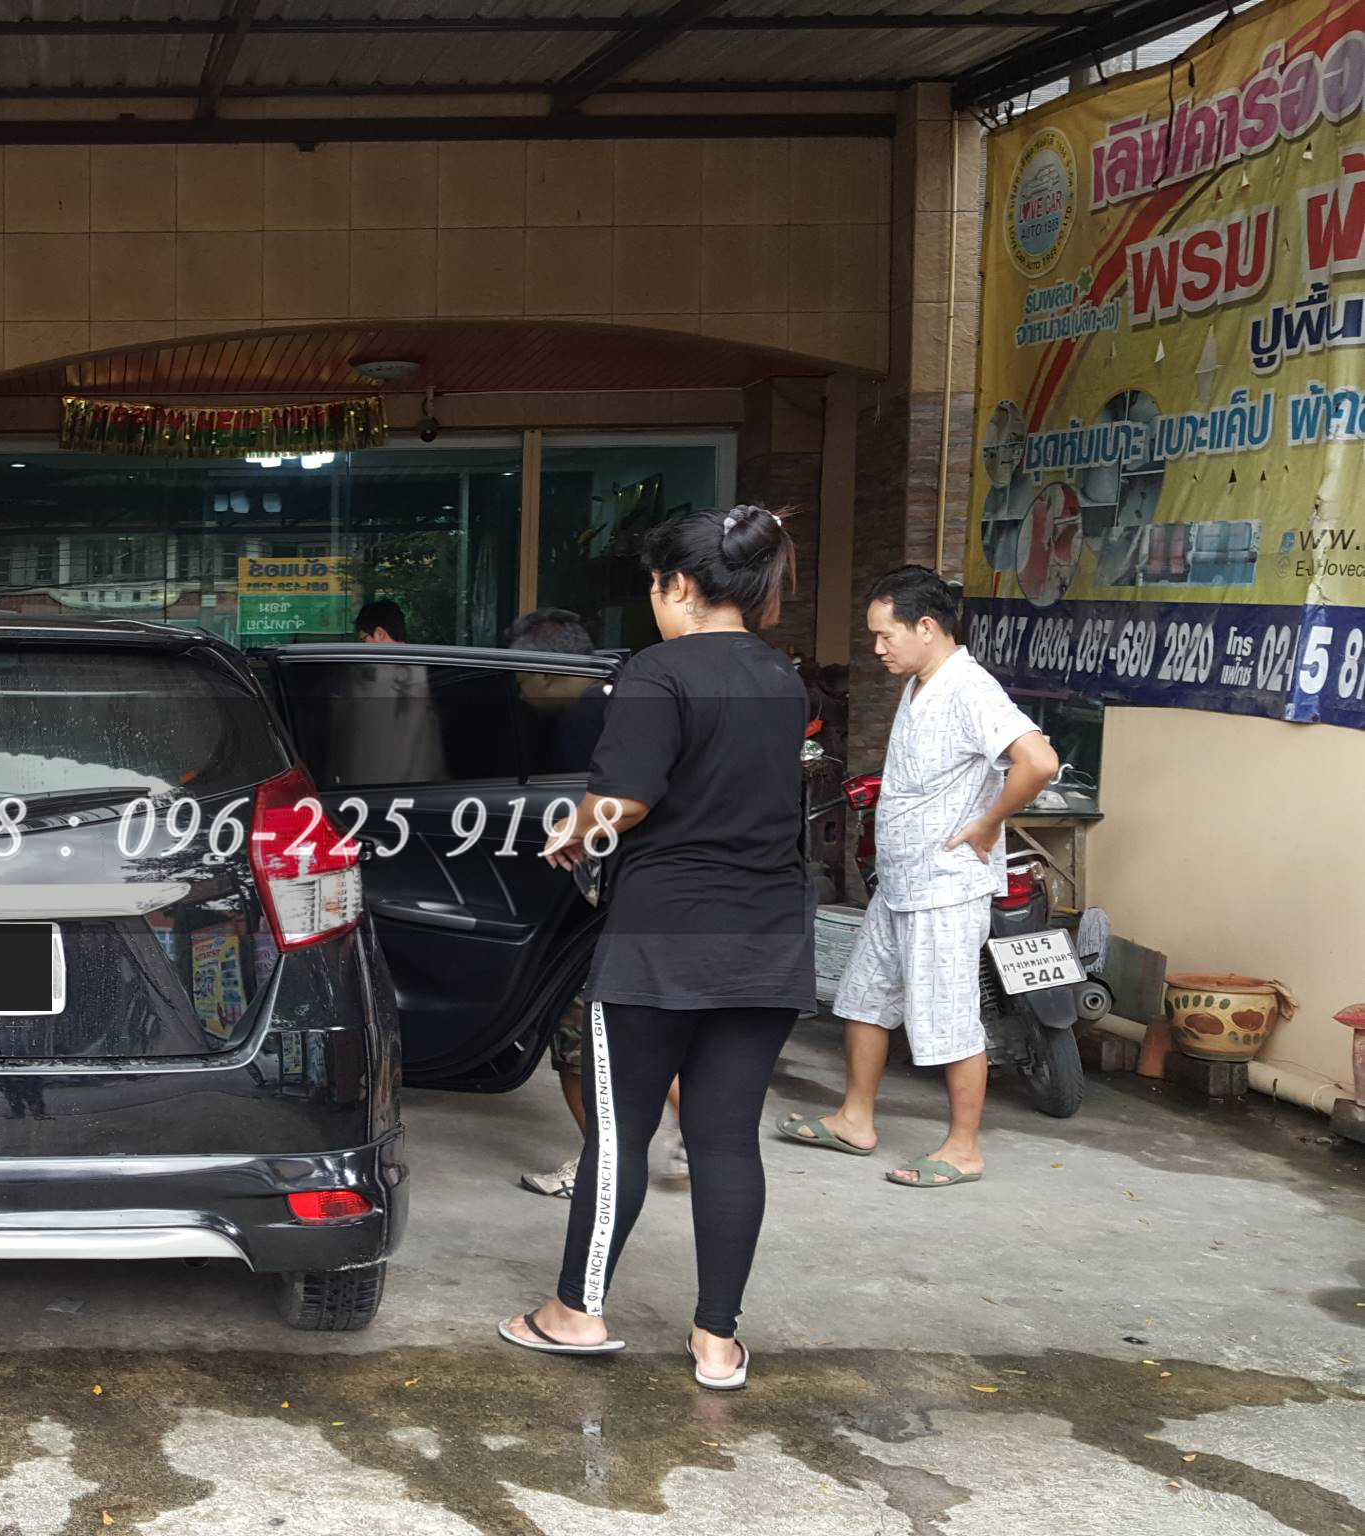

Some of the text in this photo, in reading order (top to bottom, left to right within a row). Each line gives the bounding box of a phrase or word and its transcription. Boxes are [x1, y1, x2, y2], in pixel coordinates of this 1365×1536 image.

[1002, 952, 1074, 974] กรุงเทพมหานคร
[1023, 966, 1065, 986] 244
[597, 1054, 612, 1131] GIVENCHY
[598, 1150, 612, 1225] GIVENCHY
[587, 1241, 606, 1302] GIVENCHY
